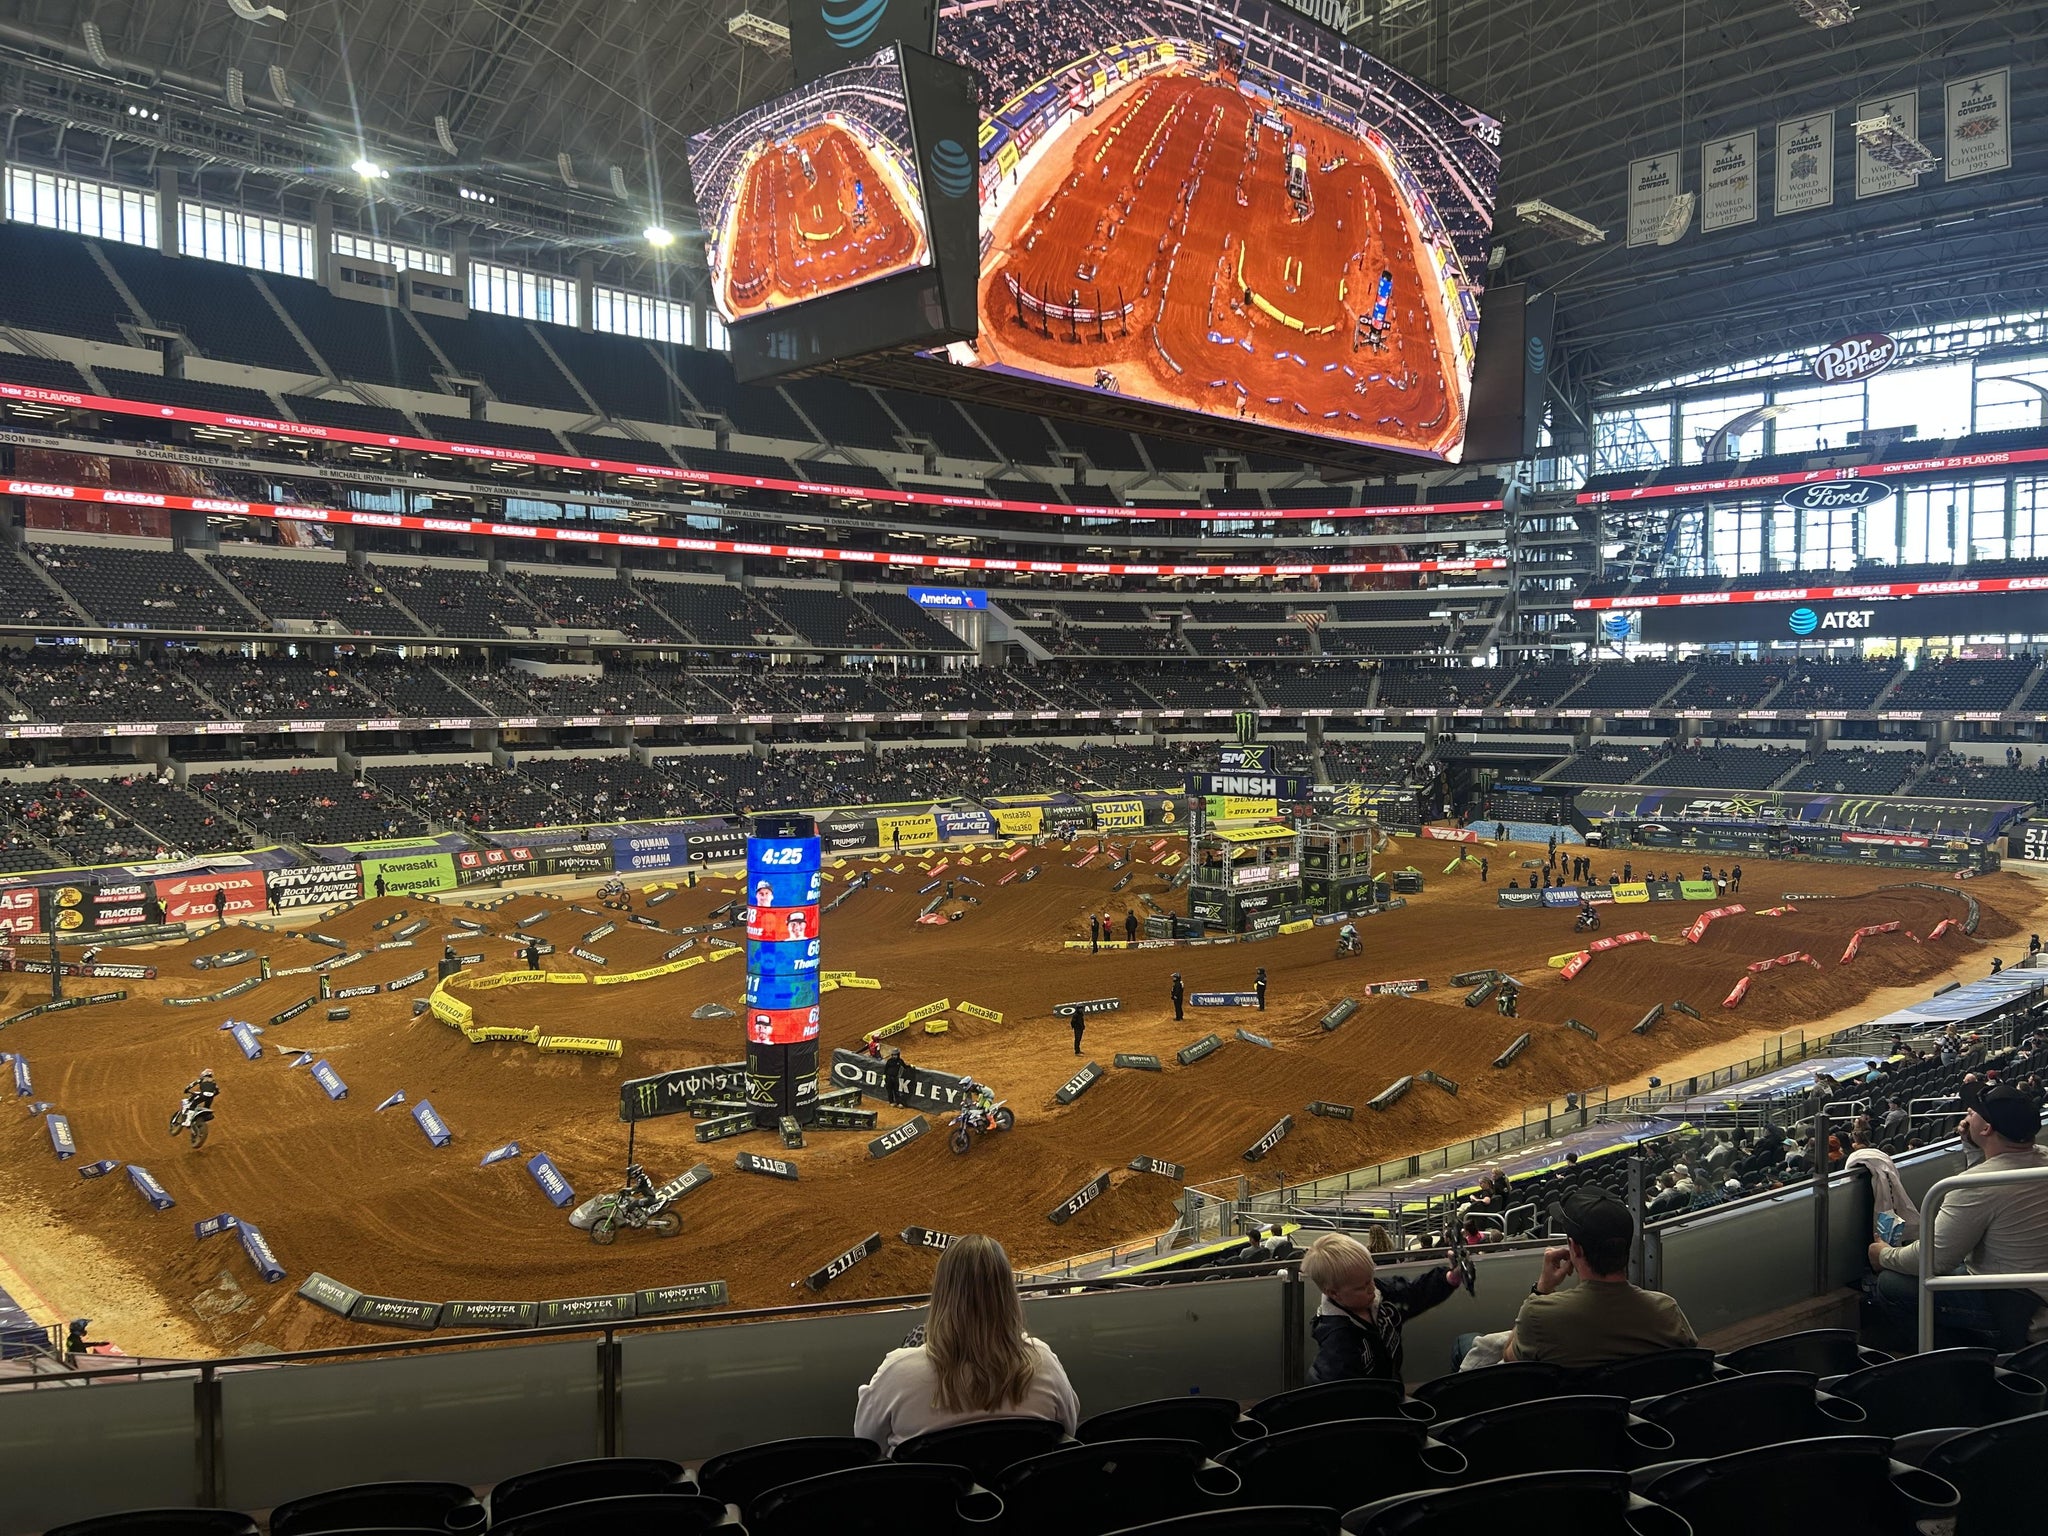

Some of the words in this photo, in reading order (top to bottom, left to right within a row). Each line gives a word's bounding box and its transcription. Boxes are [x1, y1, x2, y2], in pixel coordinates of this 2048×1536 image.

[880, 50, 895, 66] 3:25
[1962, 94, 1993, 108] DALLAS
[1958, 101, 1997, 117] COWBOYS
[1478, 122, 1501, 146] 3:25
[1791, 135, 1819, 147] DALLAS
[1788, 142, 1822, 155] COWBOYS
[1961, 143, 1994, 155] WORLD
[1715, 154, 1743, 166] DALLAS
[1951, 149, 2006, 167] CHAMPIONS
[1713, 160, 1746, 174] COWBOYS
[1969, 161, 1988, 171] 1995
[1641, 172, 1667, 184] DALLAS
[1708, 179, 1728, 191] SUPER
[1729, 175, 1749, 186] BOWL
[1861, 170, 1901, 185] CHAMPIO
[1638, 179, 1669, 191] COWBOYS
[1789, 180, 1819, 191] WORLD
[1878, 180, 1897, 190] 1993
[1780, 186, 1828, 202] CHAMPIONS
[1715, 197, 1744, 209] WORLD
[1795, 198, 1813, 207] 1992
[1706, 204, 1752, 220] CHAMPIONS
[1841, 340, 1872, 361] Dr
[1821, 344, 1892, 381] Pepper
[1, 387, 22, 396] THEM
[24, 389, 37, 399] 23
[38, 391, 82, 405] FLAVORS
[226, 417, 242, 425] HOW
[261, 421, 278, 430] THEM
[279, 423, 290, 431] 23
[291, 425, 327, 436] FLAVORS
[136, 449, 148, 457] 94
[149, 450, 191, 462] CHARLES
[191, 455, 220, 465] HALEY
[1883, 464, 1901, 472] HOW
[1924, 460, 1945, 468] THEM
[1947, 458, 1962, 466] 23
[1963, 454, 2010, 466] FLAVORS
[319, 469, 328, 477] 88
[330, 471, 362, 481] MICHAEL
[364, 473, 383, 482] IRVIN
[9, 483, 75, 498] GASGAS
[475, 486, 493, 494] TROY
[1674, 485, 1690, 493] HOW
[1709, 482, 1726, 490] THEM
[1727, 480, 1739, 488] 23
[1740, 476, 1780, 487] FLAVORS
[104, 491, 165, 506] GASGAS
[1803, 484, 1870, 508] Ford
[192, 499, 250, 513] GASGAS
[275, 507, 328, 520] GASGAS
[723, 509, 742, 517] LARRY
[352, 514, 402, 526] GASGAS
[1833, 585, 1890, 598] GASGAS
[1917, 581, 1980, 594] GASGAS
[920, 592, 962, 606] American
[1680, 593, 1730, 604] GASGAS
[1754, 589, 1808, 601] GASGAS
[1821, 610, 1875, 629] AT&T
[20, 726, 64, 735] MILITARY
[117, 724, 158, 732] MILITARY
[207, 723, 245, 731] MILITARY
[1220, 749, 1264, 769] SMX
[1211, 776, 1277, 796] FINISH
[1053, 806, 1084, 814] MONSTER
[1095, 802, 1142, 814] SUZUKI
[941, 811, 985, 822] FALKEN
[1002, 811, 1031, 819] Insta360
[1097, 815, 1142, 827] SUZUKI
[890, 819, 931, 828] DUNLOP
[946, 822, 990, 832] FALKEN
[1006, 824, 1032, 832] Insta360
[706, 832, 750, 843] OAKLEY
[1236, 828, 1288, 838] DUNLOP
[1430, 829, 1470, 842] FLY
[573, 841, 607, 853] amazon
[639, 837, 670, 848] YAMAHA
[559, 856, 601, 868] MONSTER
[640, 854, 671, 864] YAMAHA
[762, 848, 804, 865] 4:25
[281, 866, 309, 876] ROCKY
[310, 863, 355, 874] MOUNTAIN
[379, 859, 438, 874] Kawasaki
[476, 862, 525, 878] MONSTER
[1240, 867, 1271, 878] MILITARY
[100, 885, 141, 896] TRACKER
[188, 879, 253, 894] HONDA
[283, 885, 312, 896] ROCKY
[313, 883, 358, 894] MOUNTAIN
[1552, 888, 1579, 898] YAMAHA
[1686, 886, 1712, 894] Kawasaki
[1500, 892, 1534, 901] TRIUMPH
[1615, 889, 1648, 898] SUZUKI
[100, 907, 143, 919] TRACKER
[1693, 920, 1706, 937] FLY
[1569, 957, 1582, 975] FLY
[511, 974, 545, 983] DUNLOP
[636, 968, 665, 979] Insta360
[437, 1001, 464, 1020] DUNLOP
[914, 1002, 945, 1019] Insta360
[967, 1004, 998, 1020] Insta360
[485, 1034, 528, 1042] DUNLOP
[1065, 1075, 1086, 1095] 5.11
[880, 1129, 908, 1150] 5.11
[751, 1156, 776, 1172] 5.11
[1150, 1159, 1167, 1175] 5.11
[655, 1184, 682, 1203] 5.11
[1069, 1192, 1090, 1214] 5.11
[923, 1230, 948, 1249] 5.11
[827, 1254, 855, 1280] 5.11
[659, 1286, 708, 1299] MONSTER
[562, 1298, 613, 1312] MONSTER
[668, 1295, 701, 1304] ENERGY
[376, 1302, 420, 1316] MONSTER
[467, 1304, 516, 1315] MONSTER
[570, 1308, 605, 1316] ENERGY
